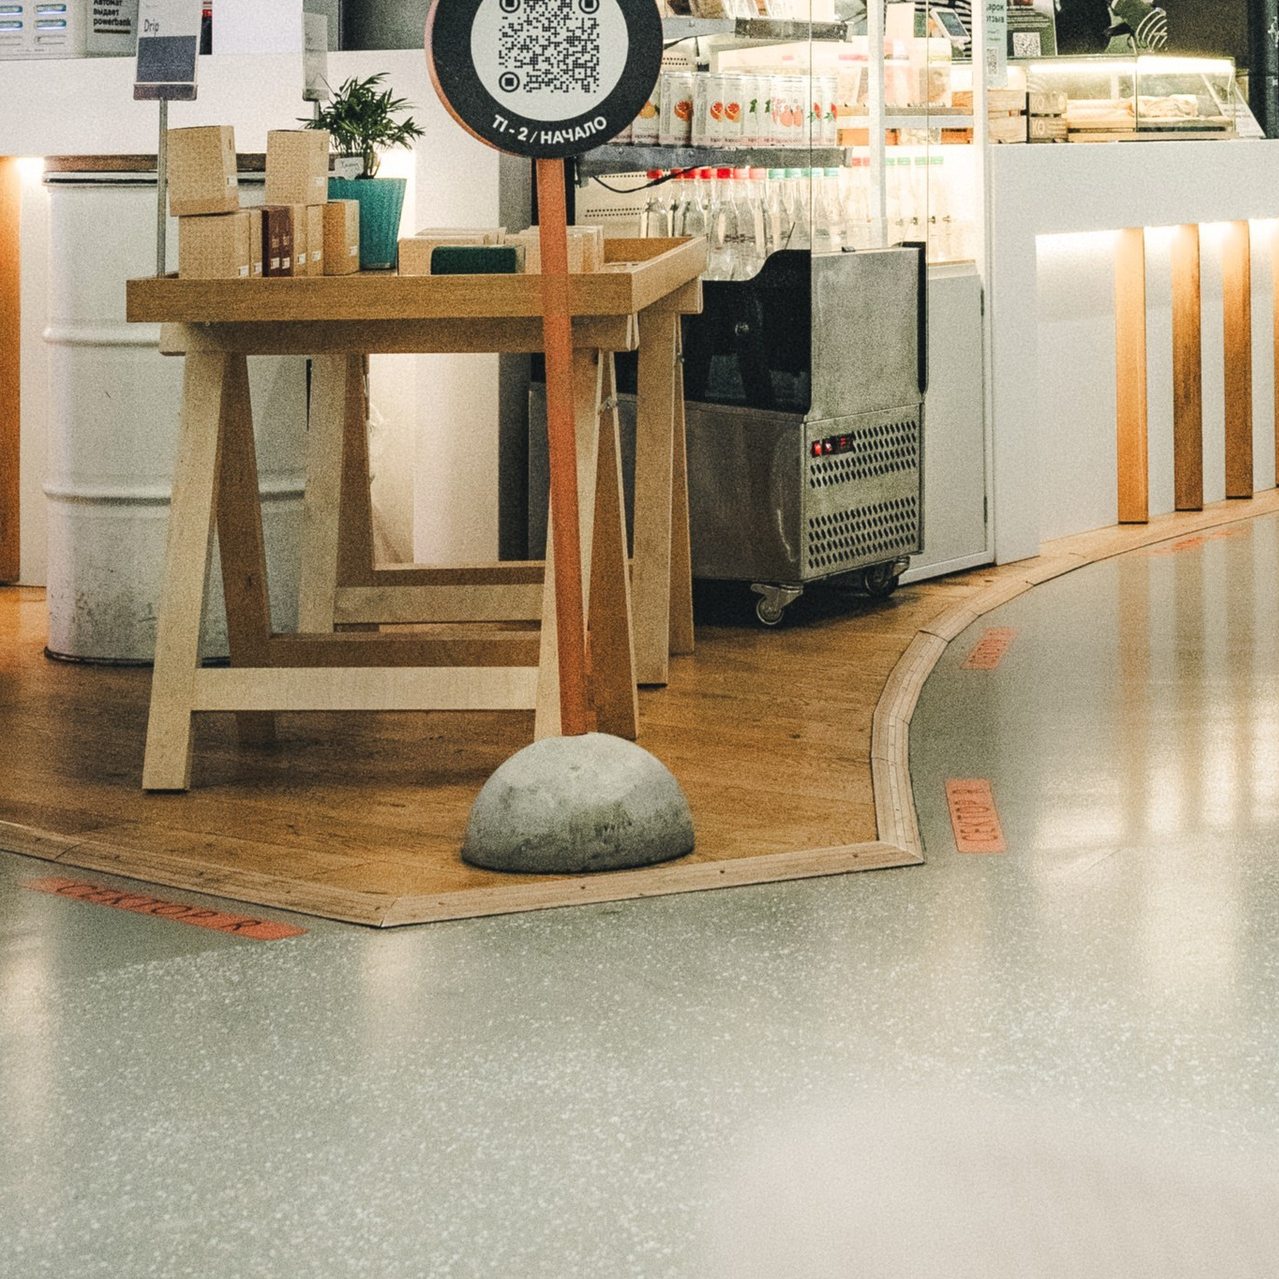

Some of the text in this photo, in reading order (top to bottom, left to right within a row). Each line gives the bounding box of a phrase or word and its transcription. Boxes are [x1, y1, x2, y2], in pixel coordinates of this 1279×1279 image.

[93, 7, 119, 17] выдает
[93, 17, 131, 28] powerbank
[144, 18, 160, 36] Drip
[517, 127, 528, 141] 2
[541, 115, 607, 144] НАЧАЛО
